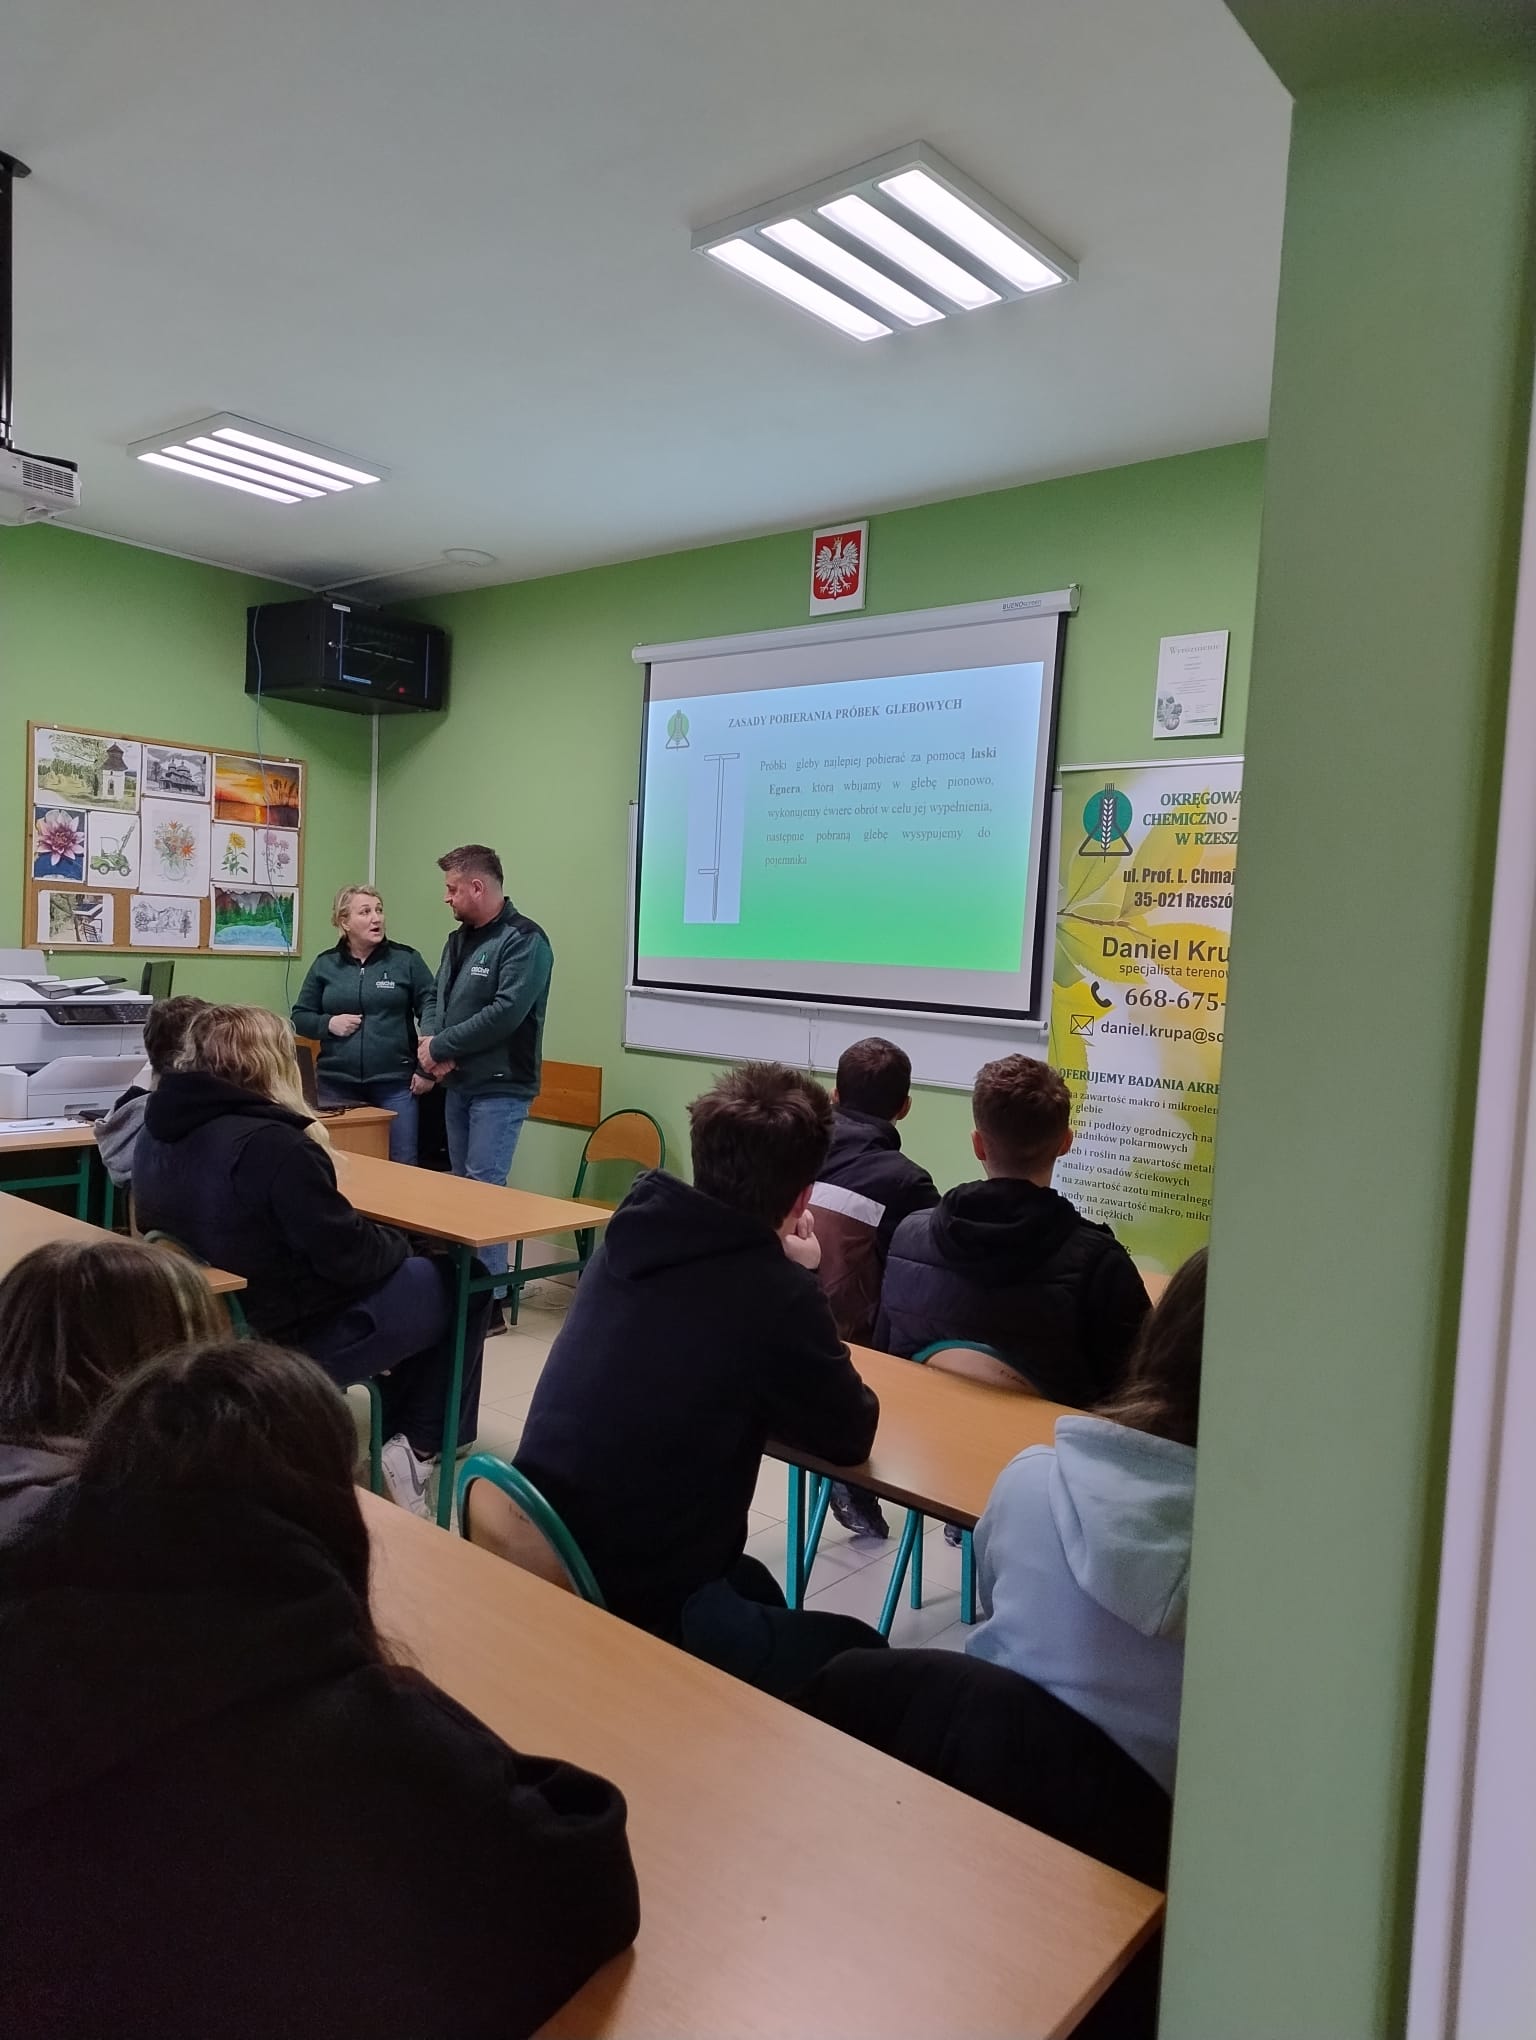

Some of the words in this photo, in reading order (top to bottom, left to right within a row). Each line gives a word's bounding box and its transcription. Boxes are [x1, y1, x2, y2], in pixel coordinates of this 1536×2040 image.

[728, 714, 768, 729] ZASADY
[769, 708, 833, 726] POBIERANIA
[835, 704, 880, 720] PRÓBEK
[885, 698, 963, 716] GLEBOWYCH
[760, 759, 787, 772] Próbki
[796, 758, 819, 772] gleby
[823, 755, 862, 769] najlepiej
[866, 751, 906, 767] pobierać
[911, 753, 921, 762] za
[926, 750, 966, 765] pomocą
[971, 746, 997, 759] laski
[844, 778, 882, 793] wbijamy
[892, 780, 900, 790] w
[911, 776, 937, 791] glebę
[1160, 790, 1242, 808] OKRĘGOWA
[767, 806, 821, 821] wykonujemy
[854, 802, 879, 815] obrót
[880, 804, 889, 814] w
[891, 802, 911, 814] celu
[913, 804, 926, 816] jej
[1143, 812, 1228, 826] CHEMICZNO
[766, 830, 805, 843] następnie
[863, 826, 889, 842] glebę
[902, 829, 962, 841] wysypujemy
[977, 825, 991, 838] do
[1175, 833, 1191, 846] W
[1194, 831, 1239, 845] RZESZ
[1123, 868, 1139, 883] ul.
[1142, 868, 1174, 884] Prof.
[1177, 868, 1188, 883] L.
[1134, 891, 1183, 908] 35-021
[1186, 892, 1233, 909] Rzeszó
[1102, 936, 1179, 961] Daniel
[1188, 940, 1231, 963] Kru
[1119, 964, 1182, 977] specjalista
[1128, 1075, 1185, 1091] BADANIA
[1080, 1091, 1127, 1104] zawartość
[1129, 1097, 1160, 1108] makro
[1076, 1103, 1103, 1114] glebie
[1133, 1126, 1199, 1142] ogrodniczych
[1201, 1134, 1213, 1143] na
[1120, 1137, 1188, 1153] pokarmowych
[1089, 1149, 1117, 1160] roślin
[1119, 1154, 1131, 1162] na
[1132, 1156, 1182, 1169] zawartość
[1062, 1161, 1095, 1175] analizy
[1096, 1166, 1133, 1178] osadów
[1134, 1171, 1190, 1187] ściekowych
[1062, 1176, 1073, 1184] na
[1074, 1178, 1121, 1191] zawartość
[1122, 1185, 1149, 1196] azotu
[1061, 1191, 1085, 1203] wody
[1086, 1194, 1098, 1203] na
[1100, 1197, 1147, 1211] zawartość
[1149, 1205, 1184, 1219] makro,
[1095, 1208, 1134, 1222] ciężkich
